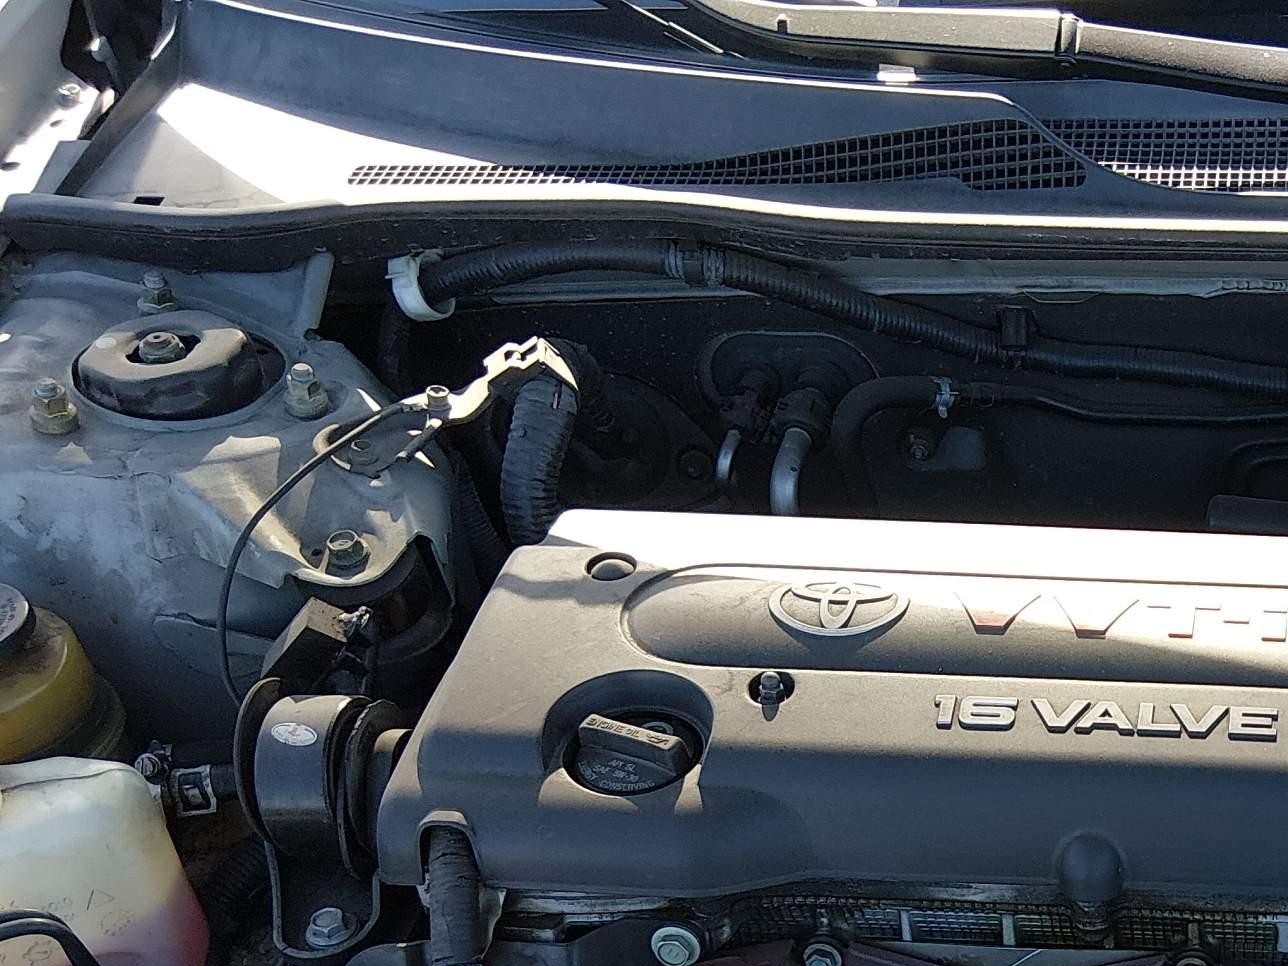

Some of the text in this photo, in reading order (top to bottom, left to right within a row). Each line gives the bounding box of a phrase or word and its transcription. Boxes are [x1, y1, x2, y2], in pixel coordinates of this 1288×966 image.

[585, 716, 641, 739] ENGINE OIL
[934, 694, 1280, 742] 16 VALVE
